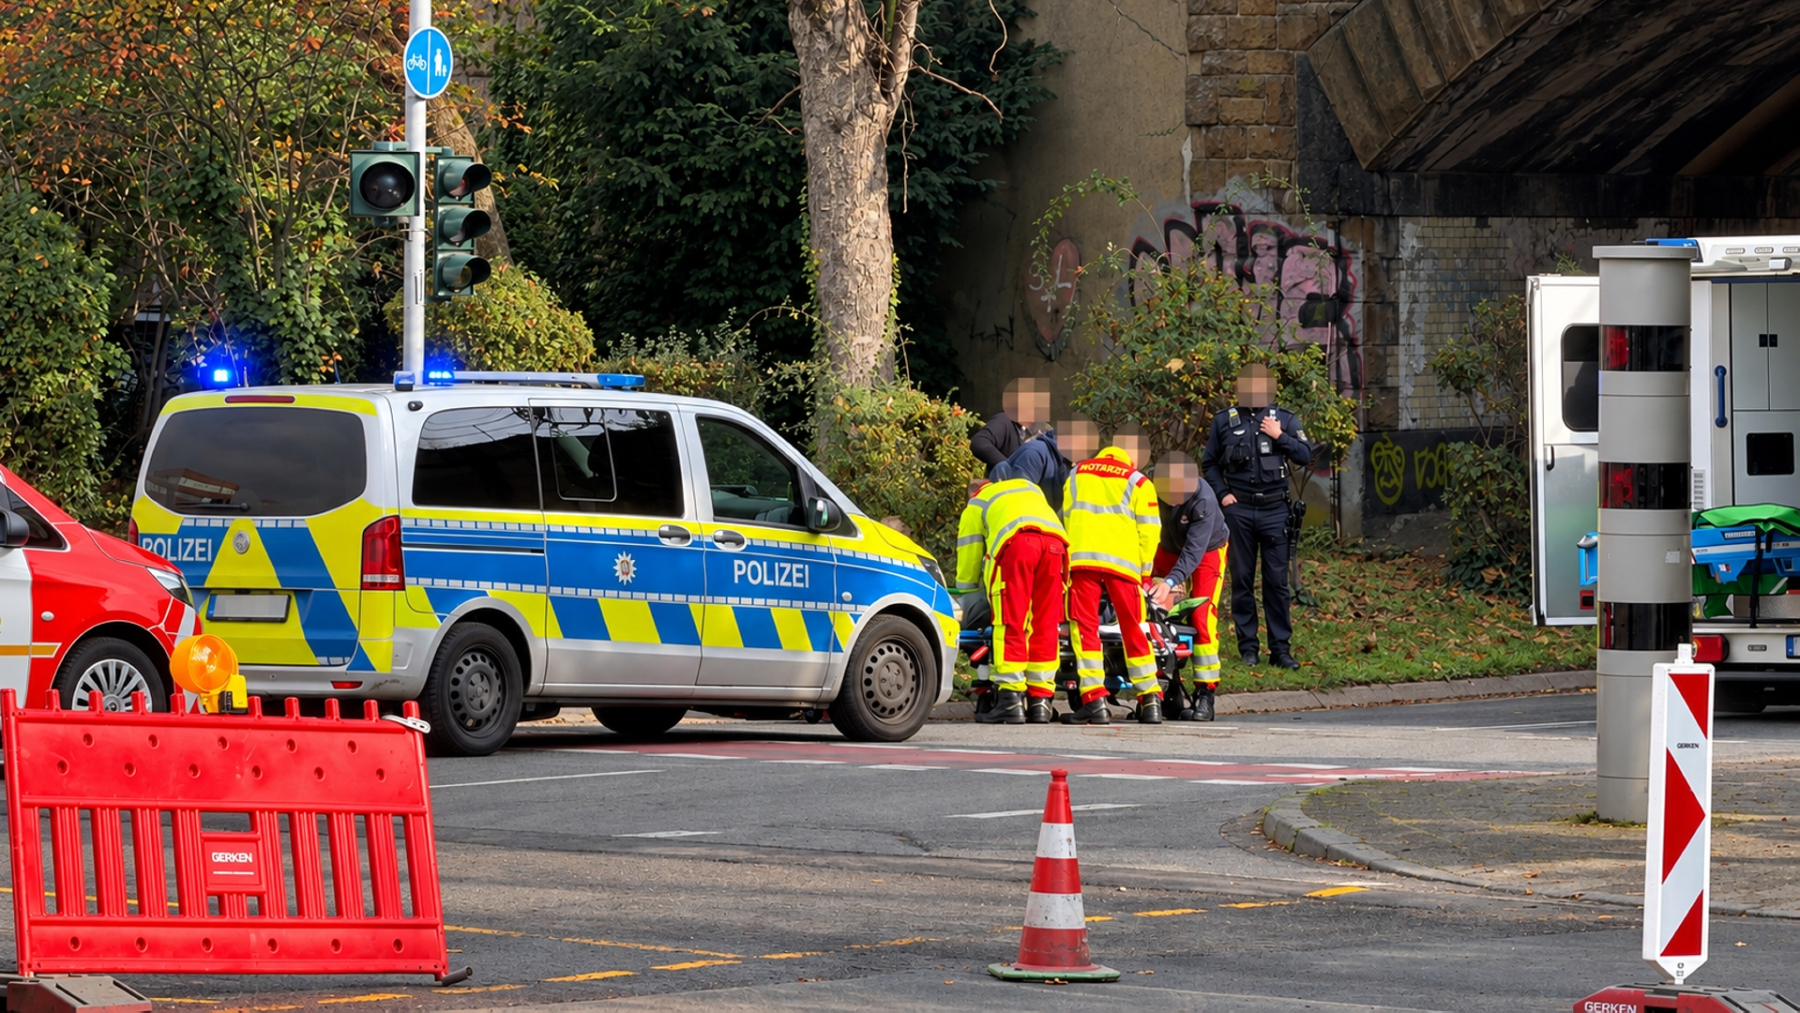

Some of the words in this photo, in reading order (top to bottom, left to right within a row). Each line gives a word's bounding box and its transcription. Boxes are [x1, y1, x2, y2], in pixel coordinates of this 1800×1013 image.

[142, 537, 212, 562] POLIZEI
[733, 559, 809, 588] POLIZEI
[211, 852, 253, 863] GERKEN
[1584, 1001, 1637, 1013] GERKEN
